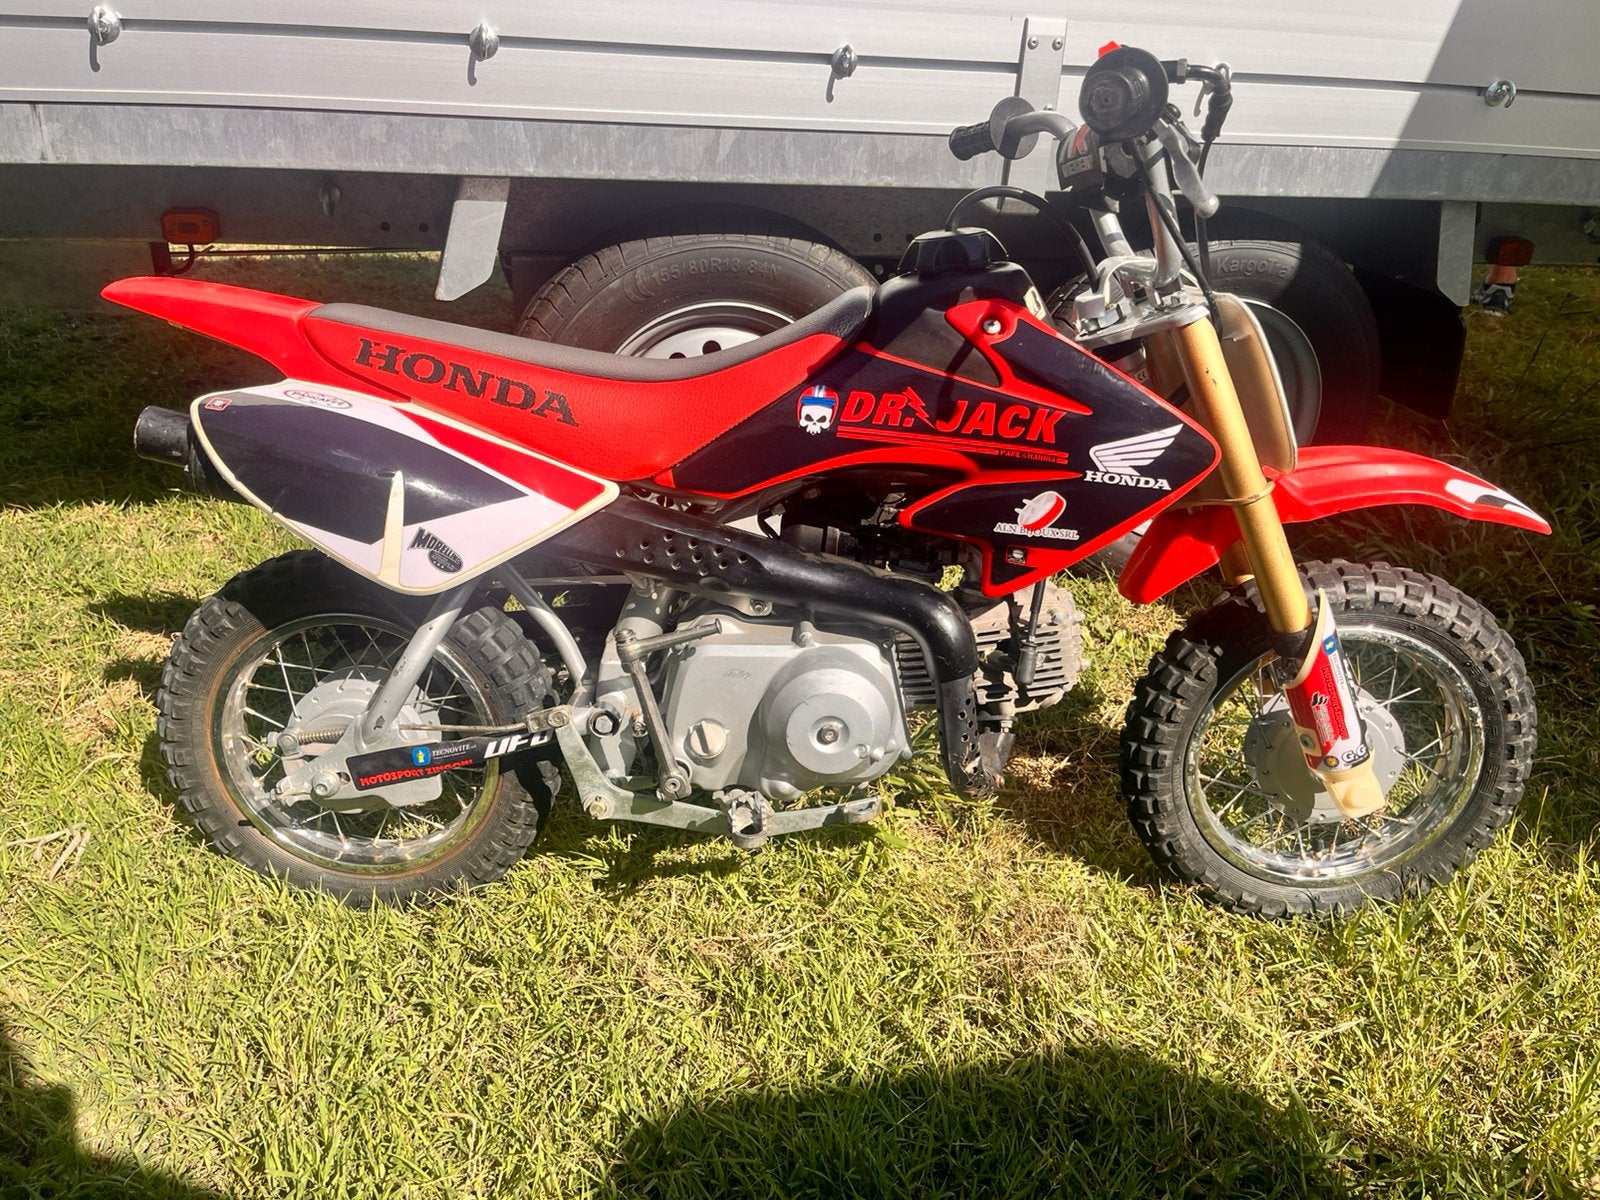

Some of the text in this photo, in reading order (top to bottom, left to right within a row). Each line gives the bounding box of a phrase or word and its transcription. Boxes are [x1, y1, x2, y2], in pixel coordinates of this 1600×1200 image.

[651, 257, 741, 287] 155/80R13
[354, 338, 579, 427] HONDA
[840, 391, 1067, 443] DR. JACK
[1084, 470, 1172, 490] HONDA
[995, 523, 1018, 533] ALN
[1019, 526, 1057, 538] BIJOUX
[432, 744, 470, 757] TECNOVITE
[359, 769, 425, 786] MOTOSPORT
